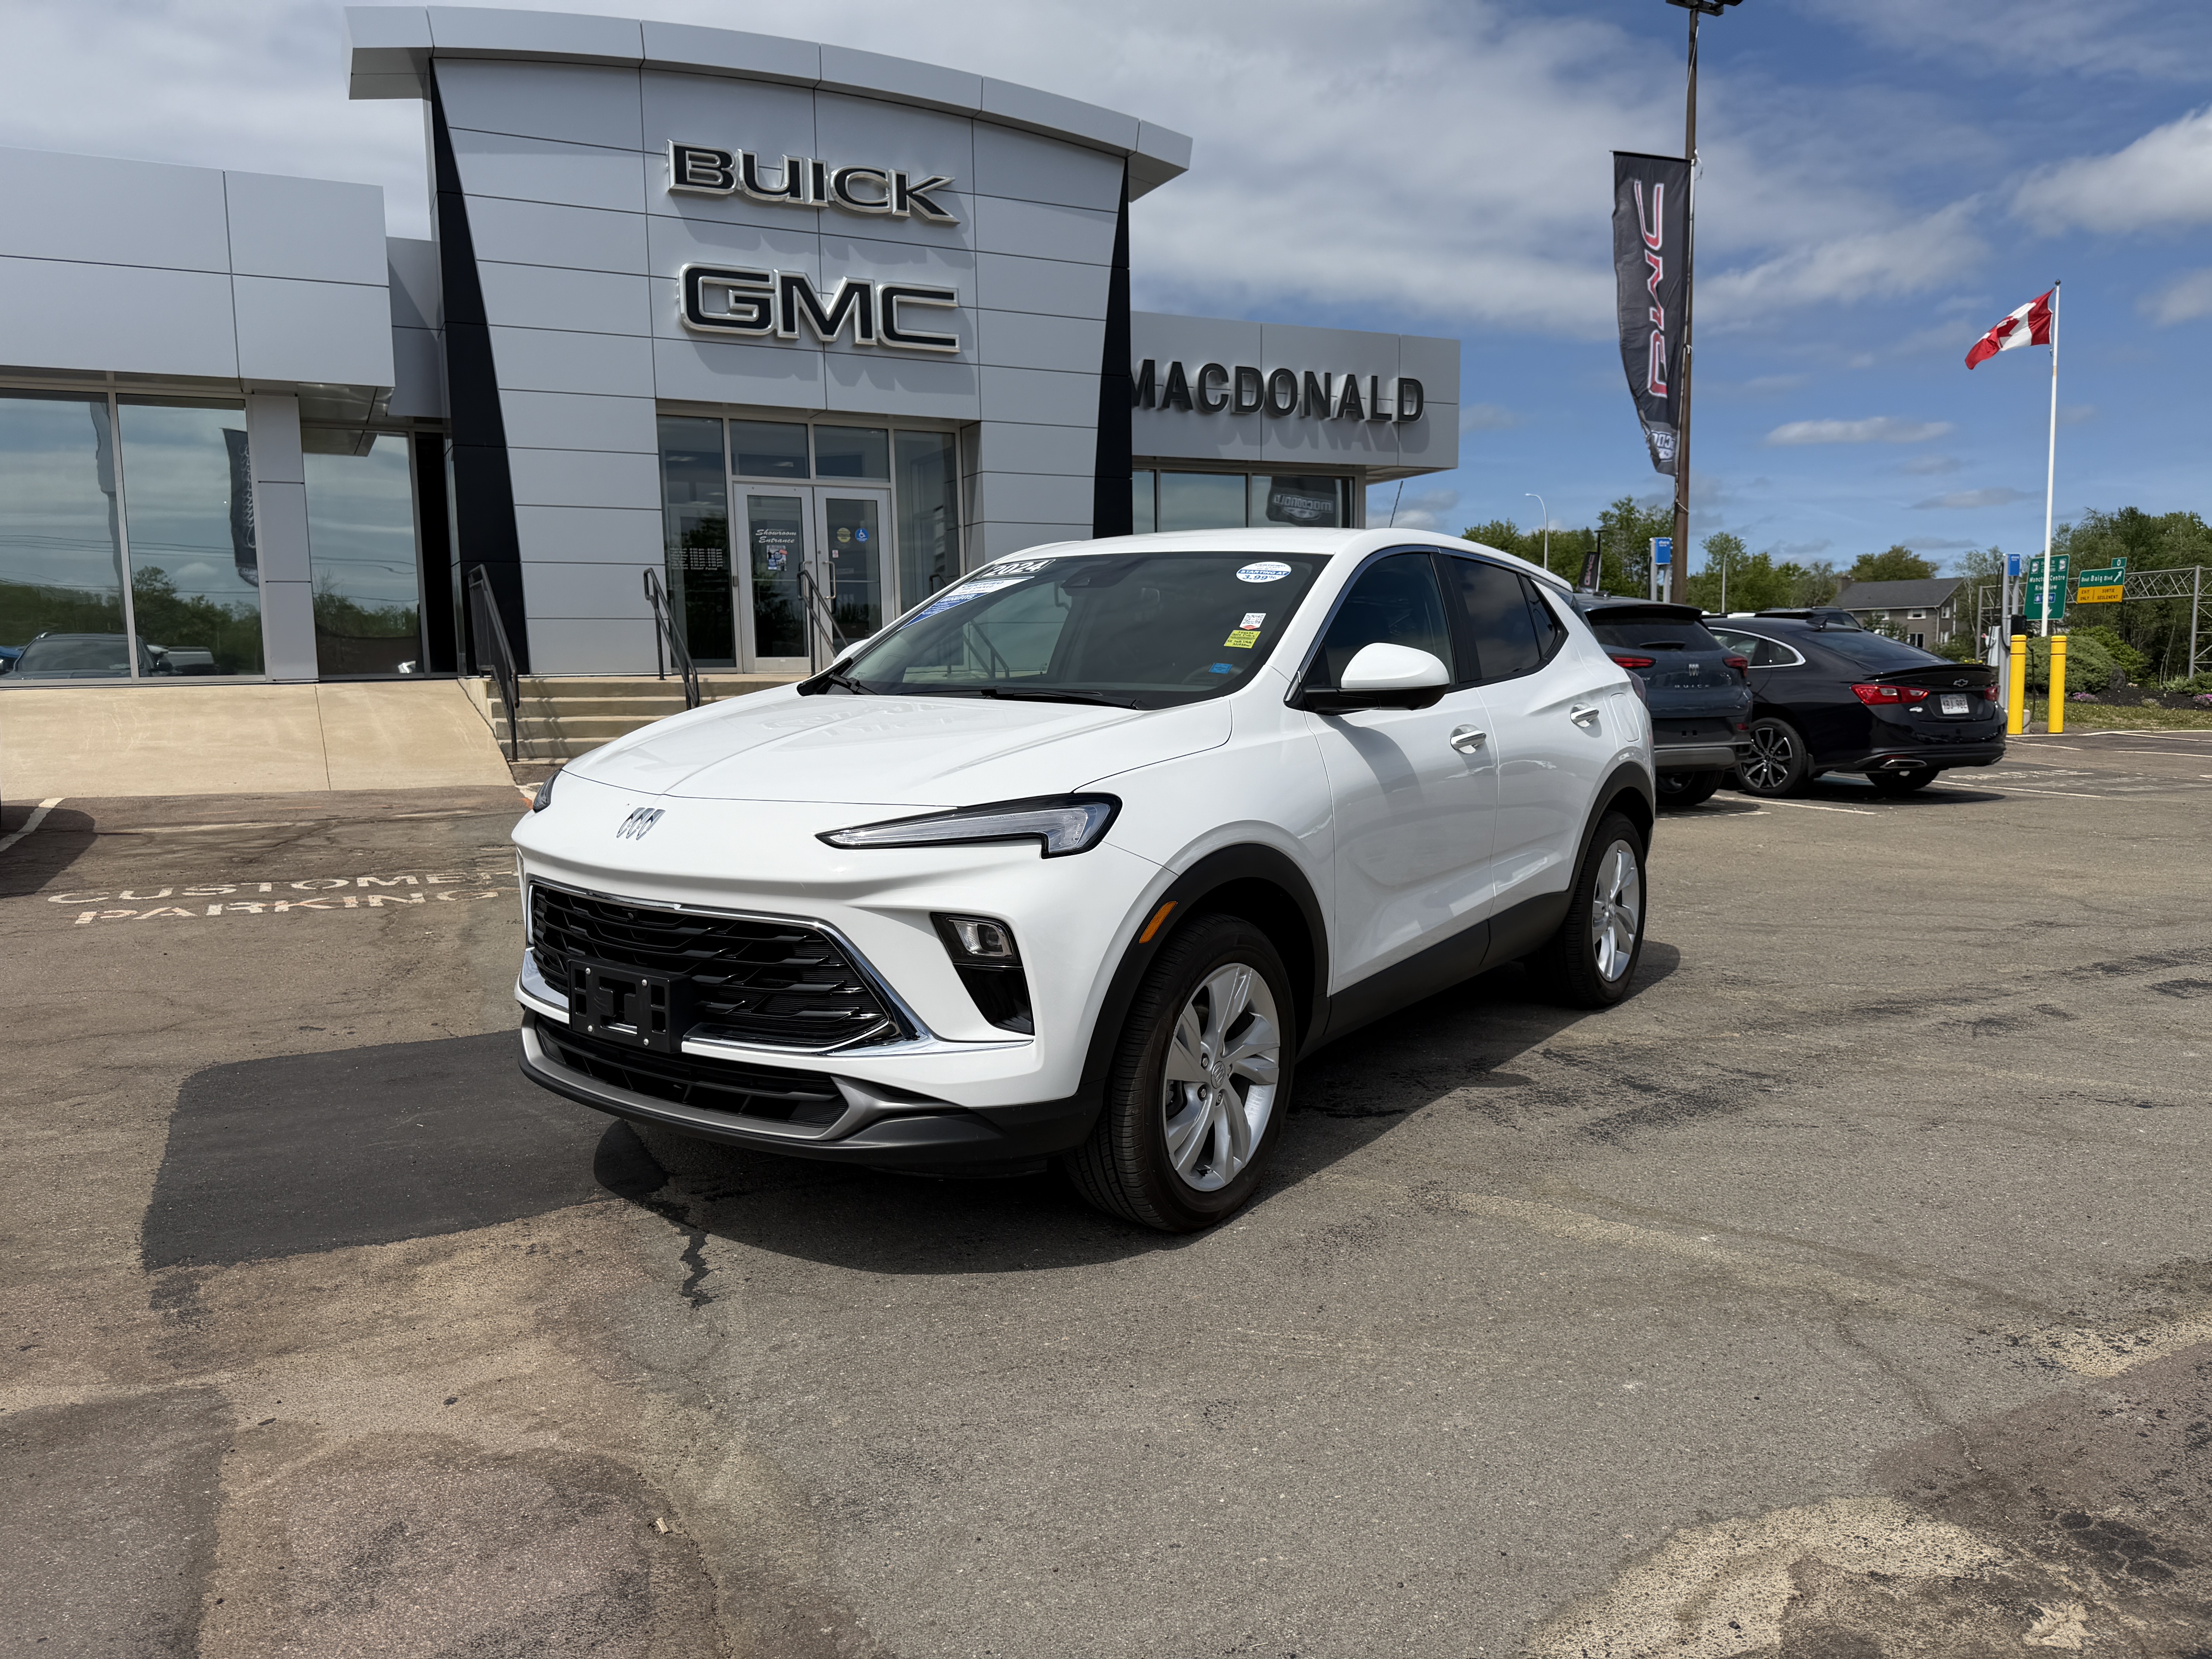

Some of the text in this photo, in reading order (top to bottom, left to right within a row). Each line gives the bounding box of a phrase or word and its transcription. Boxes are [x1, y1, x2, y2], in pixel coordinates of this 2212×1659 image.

[667, 139, 961, 225] BUICK
[678, 261, 960, 354] GMC
[1131, 359, 1424, 423] MACDONALD
[983, 560, 1049, 577] 2024
[74, 890, 499, 924] PARKING
